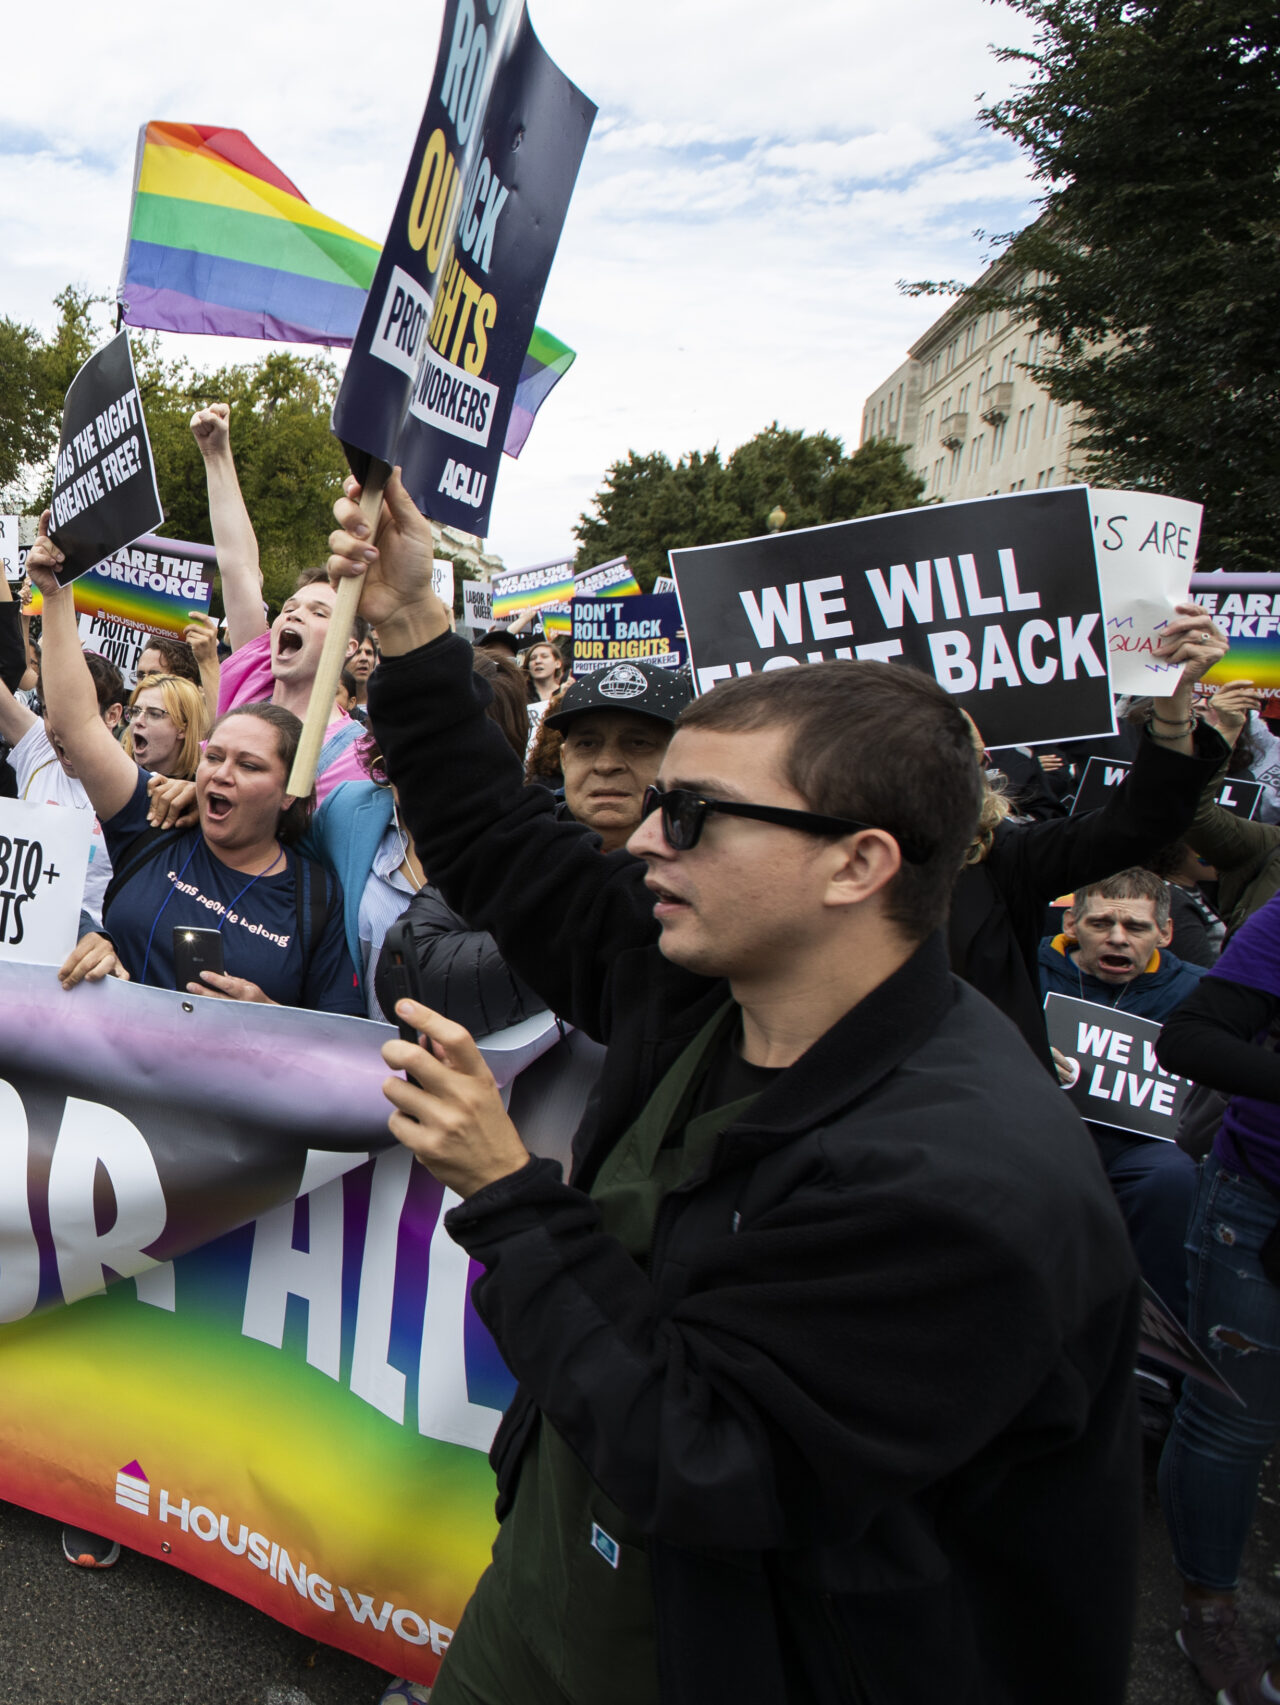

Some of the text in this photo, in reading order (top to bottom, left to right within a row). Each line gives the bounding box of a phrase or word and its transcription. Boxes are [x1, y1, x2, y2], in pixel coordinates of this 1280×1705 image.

[408, 128, 462, 274] OU
[427, 254, 497, 377] HTS
[419, 361, 490, 433] WORKERS
[56, 388, 139, 487] HAS THE RIGHT
[54, 465, 105, 528] BREATHE
[101, 435, 142, 493] FREE?
[438, 458, 488, 508] ACLU
[1138, 521, 1191, 560] ARE
[89, 562, 209, 601] ORKFORCE
[161, 556, 204, 581] THE
[495, 569, 573, 596] WORKFORCE
[545, 563, 569, 577] THE
[465, 590, 485, 604] LABOR
[574, 603, 624, 621] DON'T
[739, 548, 1040, 649] WE WILL
[106, 614, 179, 639] HOUSING WORKS
[573, 637, 670, 659] OUR RIGHTS
[574, 619, 662, 640] ROLL BACK
[927, 613, 1107, 694] BACK
[167, 871, 291, 948] trans people belong
[1077, 1021, 1134, 1065] WE
[1088, 1064, 1177, 1116] LIVE
[241, 1148, 504, 1454] ALL
[159, 1489, 454, 1657] HOUSING WOR
